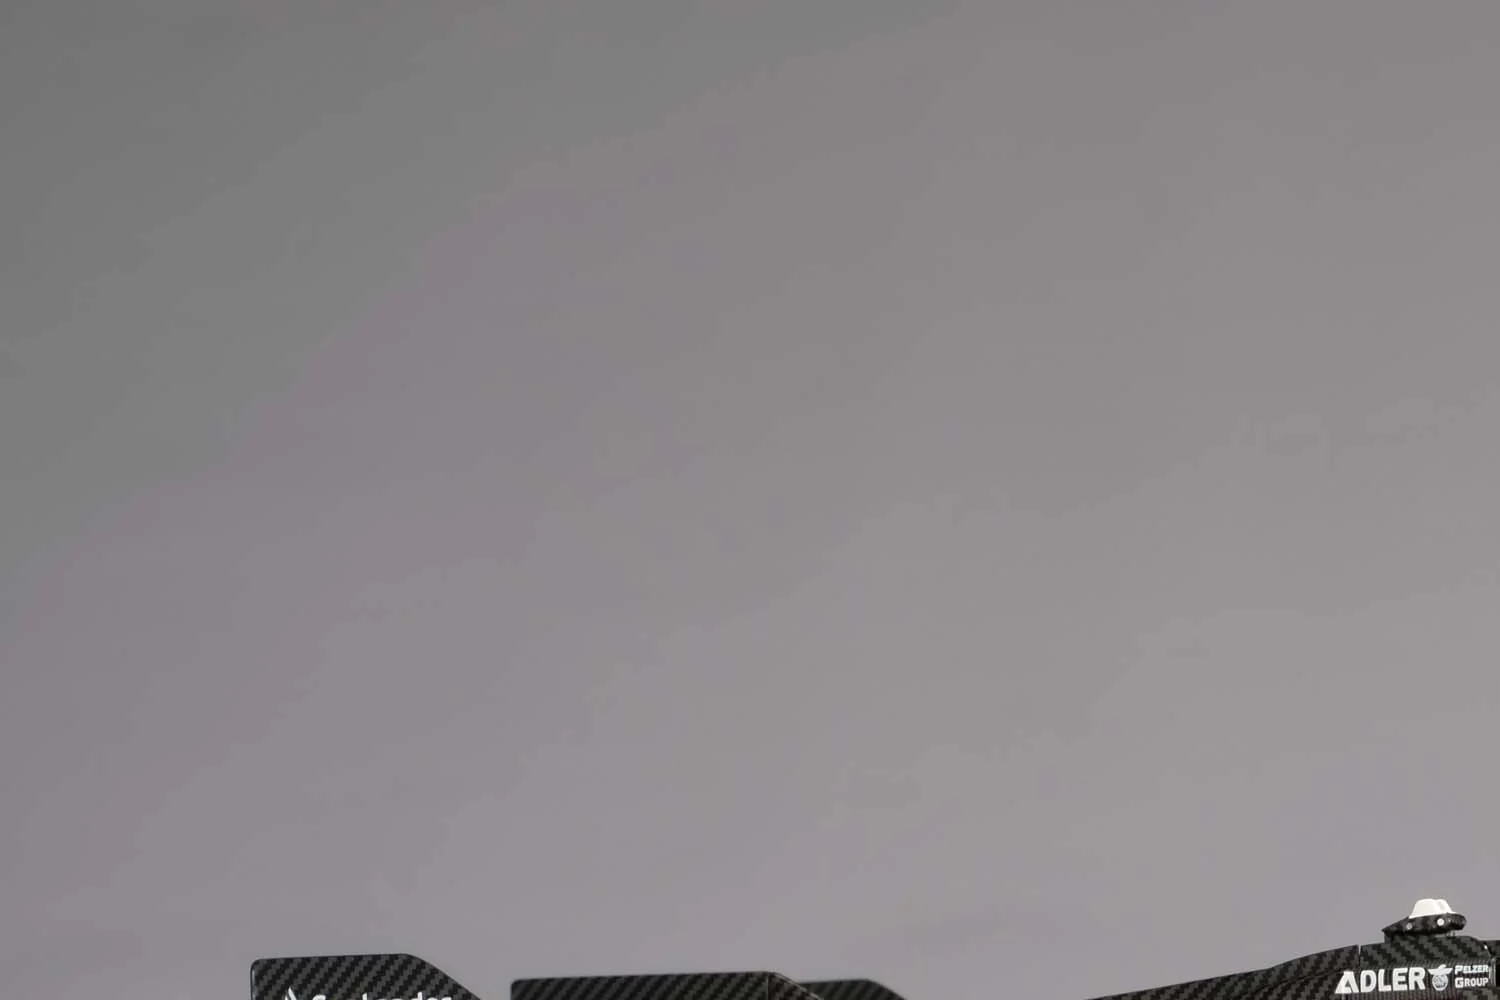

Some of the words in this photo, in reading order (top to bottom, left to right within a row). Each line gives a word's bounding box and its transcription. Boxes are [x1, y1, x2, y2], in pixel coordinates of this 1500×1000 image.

[1454, 964, 1489, 976] PELZER
[1334, 966, 1426, 994] ADLER
[1454, 977, 1489, 989] GROUP
